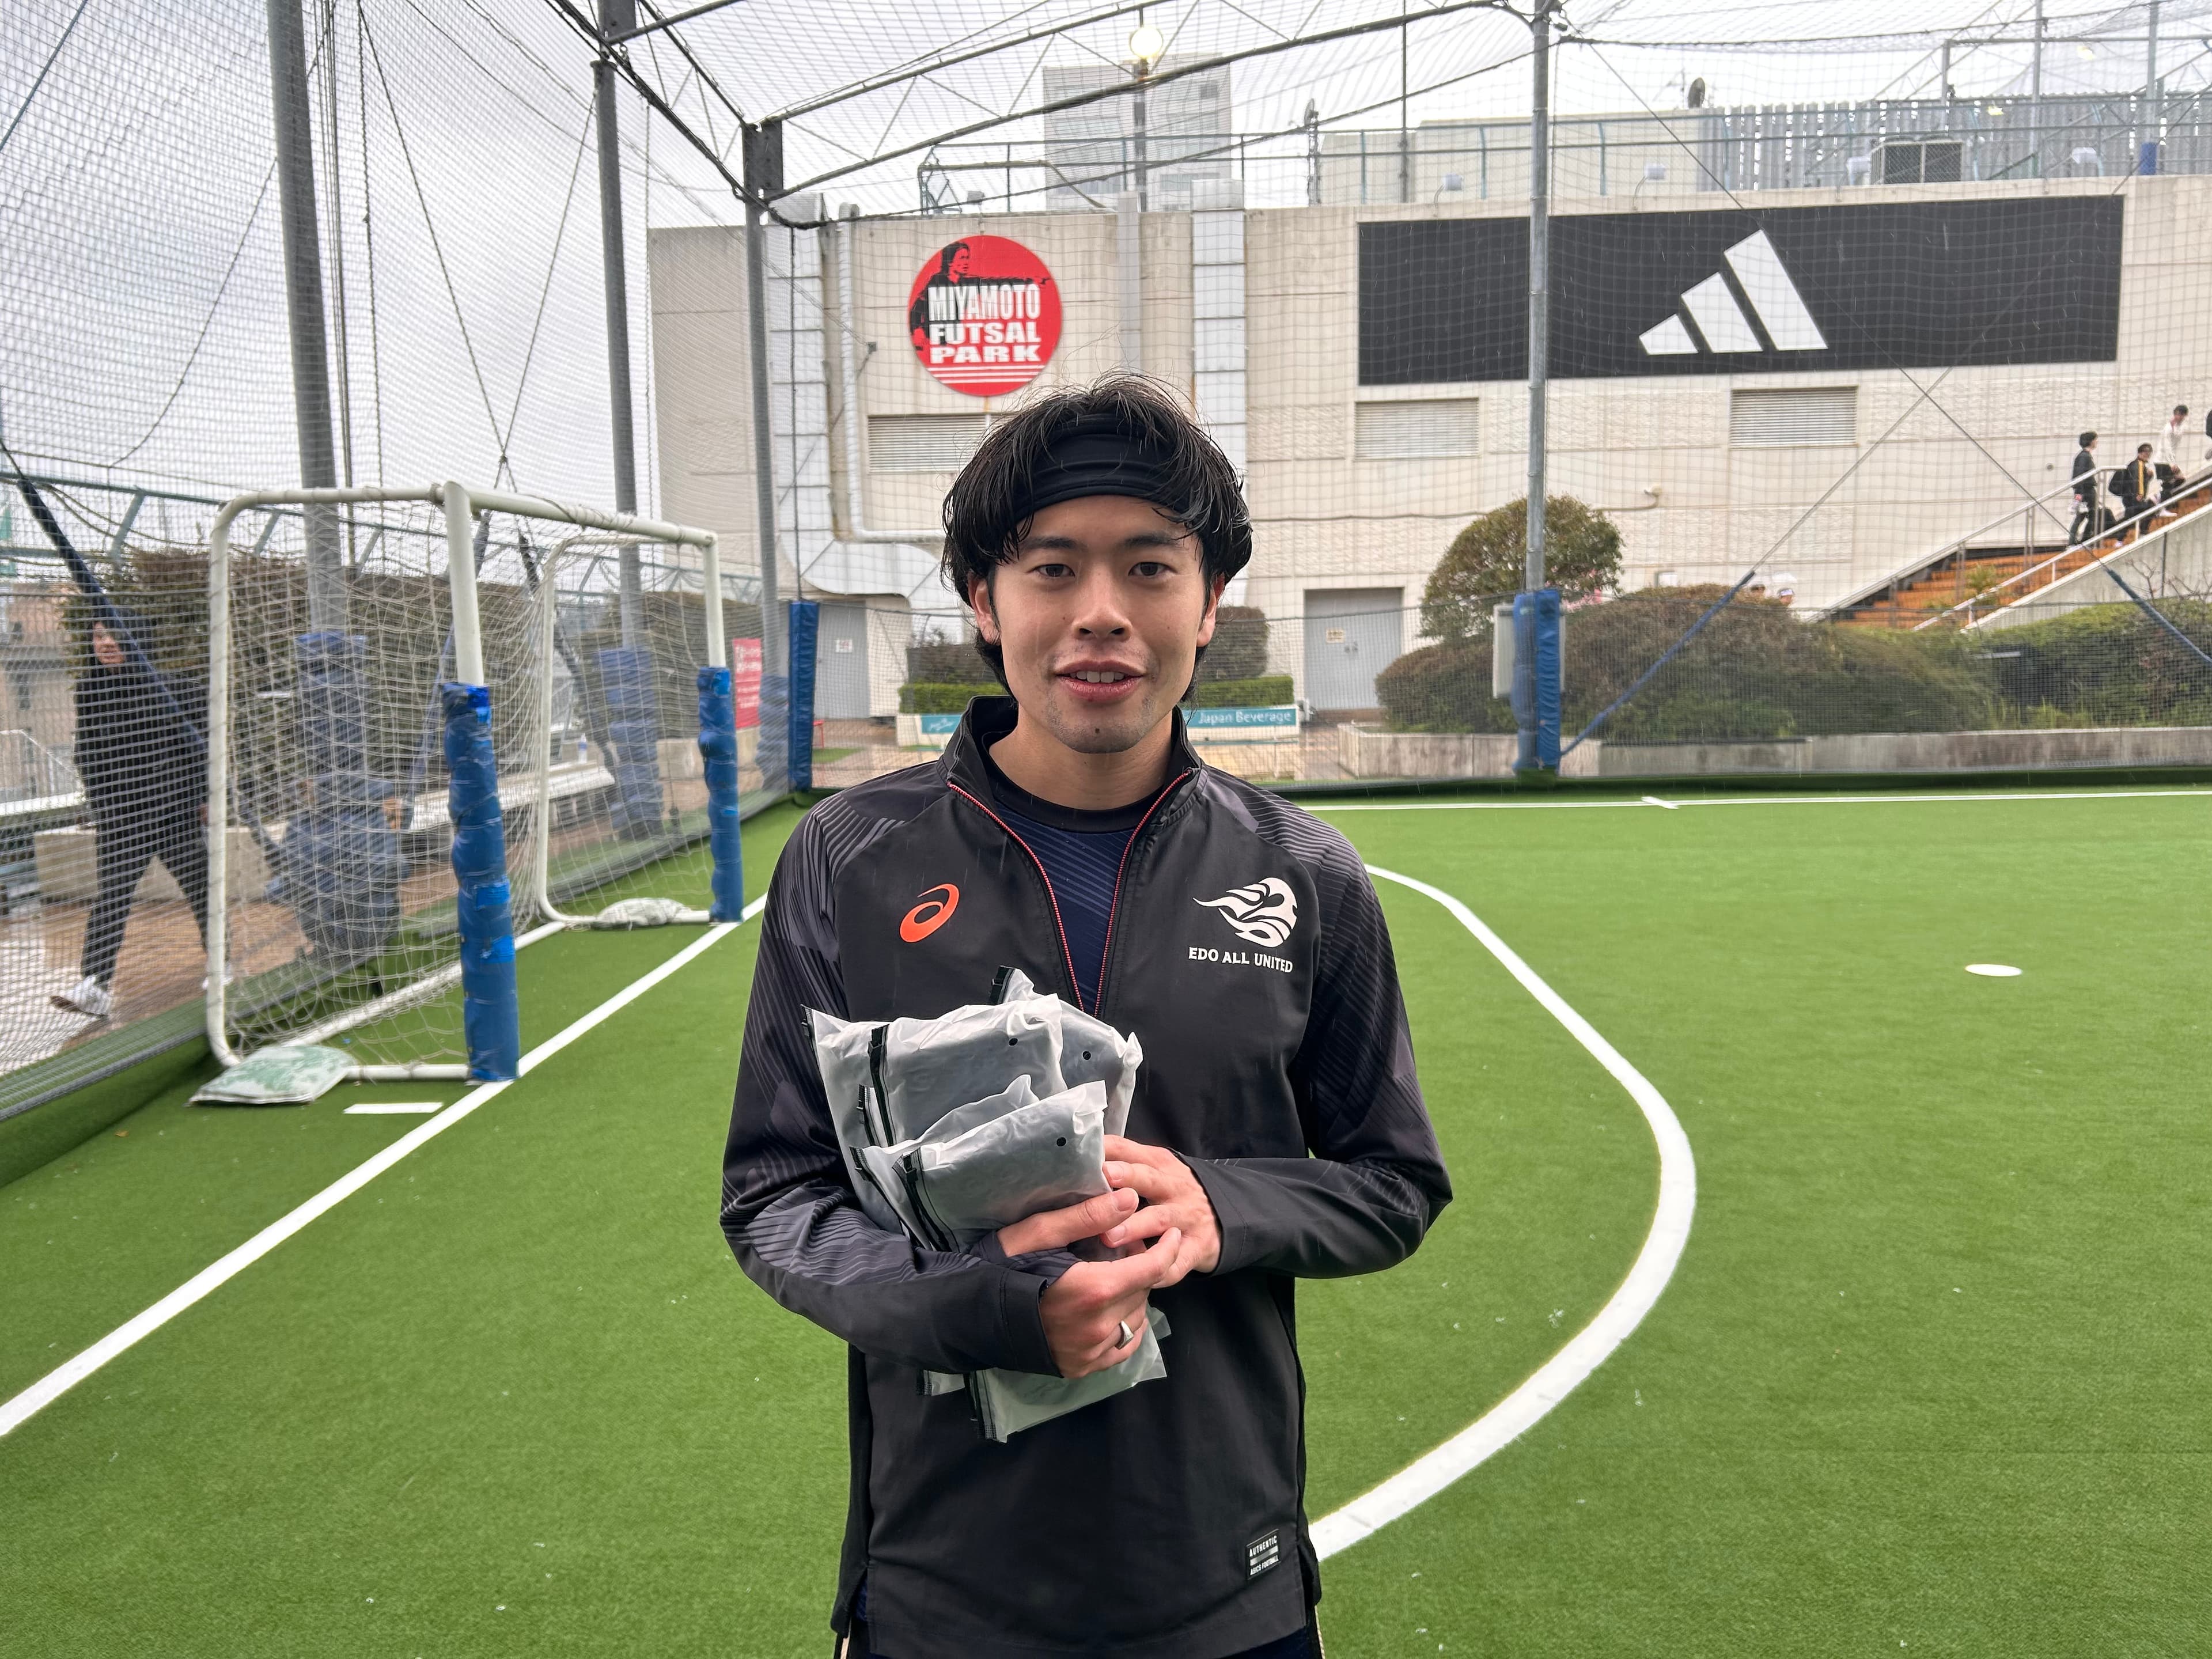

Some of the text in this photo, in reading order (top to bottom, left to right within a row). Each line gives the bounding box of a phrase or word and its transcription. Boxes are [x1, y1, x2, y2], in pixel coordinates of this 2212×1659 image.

[927, 283, 1041, 321] MIYAMOTO
[929, 321, 1041, 345] FUTSAL
[929, 345, 1041, 364] PARK
[1199, 711, 1291, 725] Japan Beverage
[1188, 946, 1293, 973] EDO ALL UNITED
[1249, 1536, 1277, 1556] AUTHENTIC
